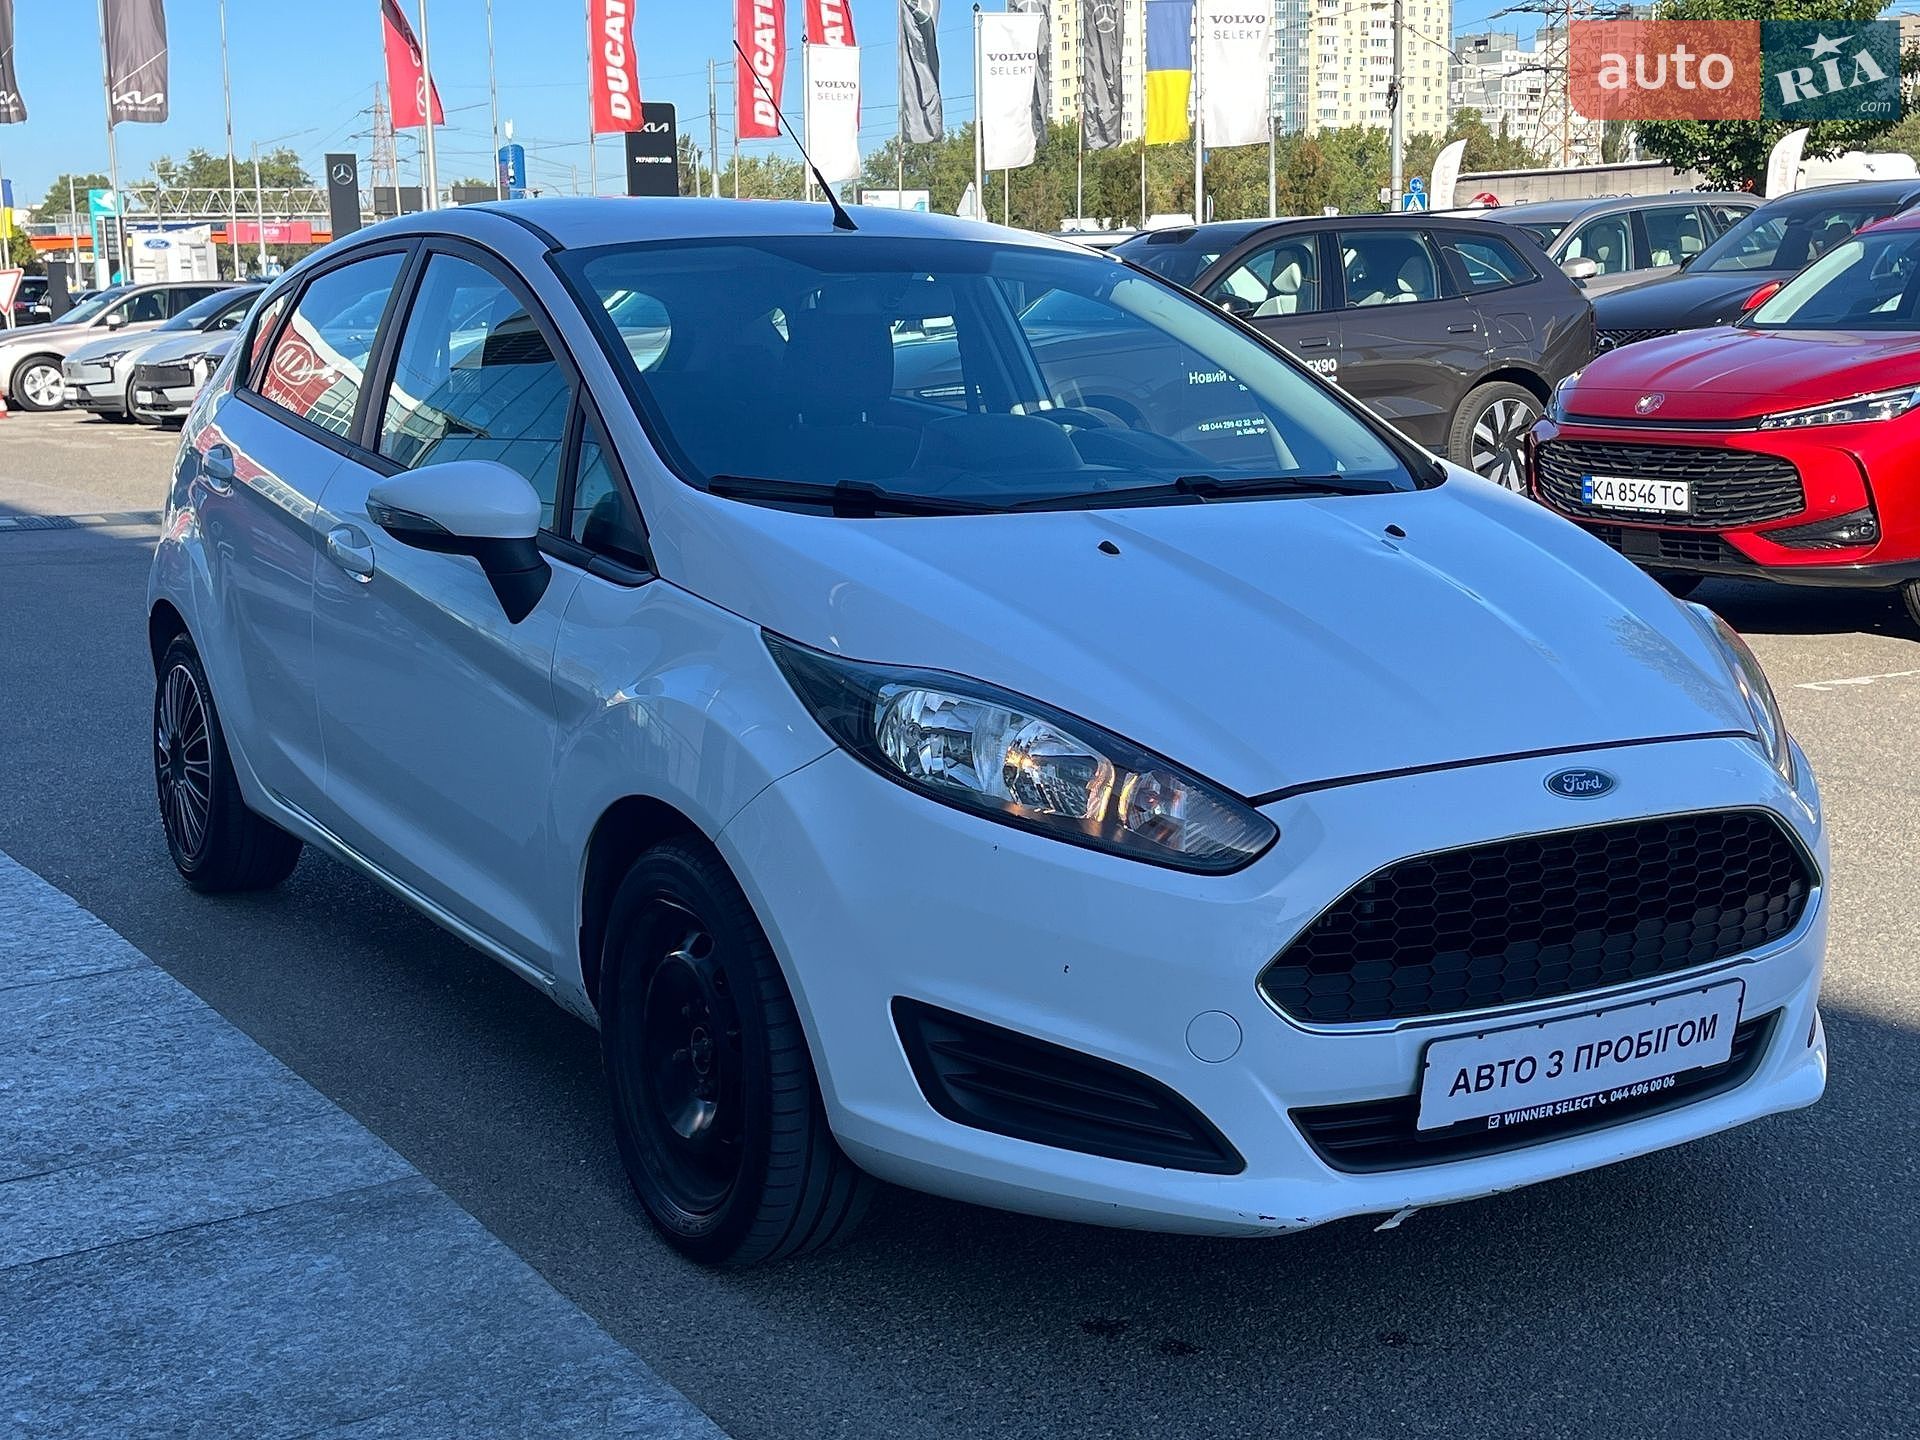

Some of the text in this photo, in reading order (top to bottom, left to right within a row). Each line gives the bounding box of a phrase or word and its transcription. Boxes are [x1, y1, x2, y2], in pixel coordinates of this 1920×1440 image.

[1209, 14, 1266, 24] VOLVO
[1213, 29, 1261, 40] SELEKT
[604, 0, 632, 121] DUCAT
[986, 52, 1036, 62] VOLVO
[990, 66, 1033, 76] SELEKT
[815, 80, 857, 90] VOLVO
[112, 90, 164, 105] KIA
[817, 92, 854, 101] SELEKT
[147, 239, 168, 249] Ford
[1188, 369, 1227, 385] Новий
[1210, 422, 1223, 430] 044
[1592, 480, 1684, 506] KA 8546 TC
[1562, 773, 1603, 793] Ford
[1448, 1055, 1537, 1098] АВТО
[1573, 1013, 1719, 1073] ПРОБІГОМ
[1504, 1075, 1676, 1126] WINNER SELECT 044 496 00 06
